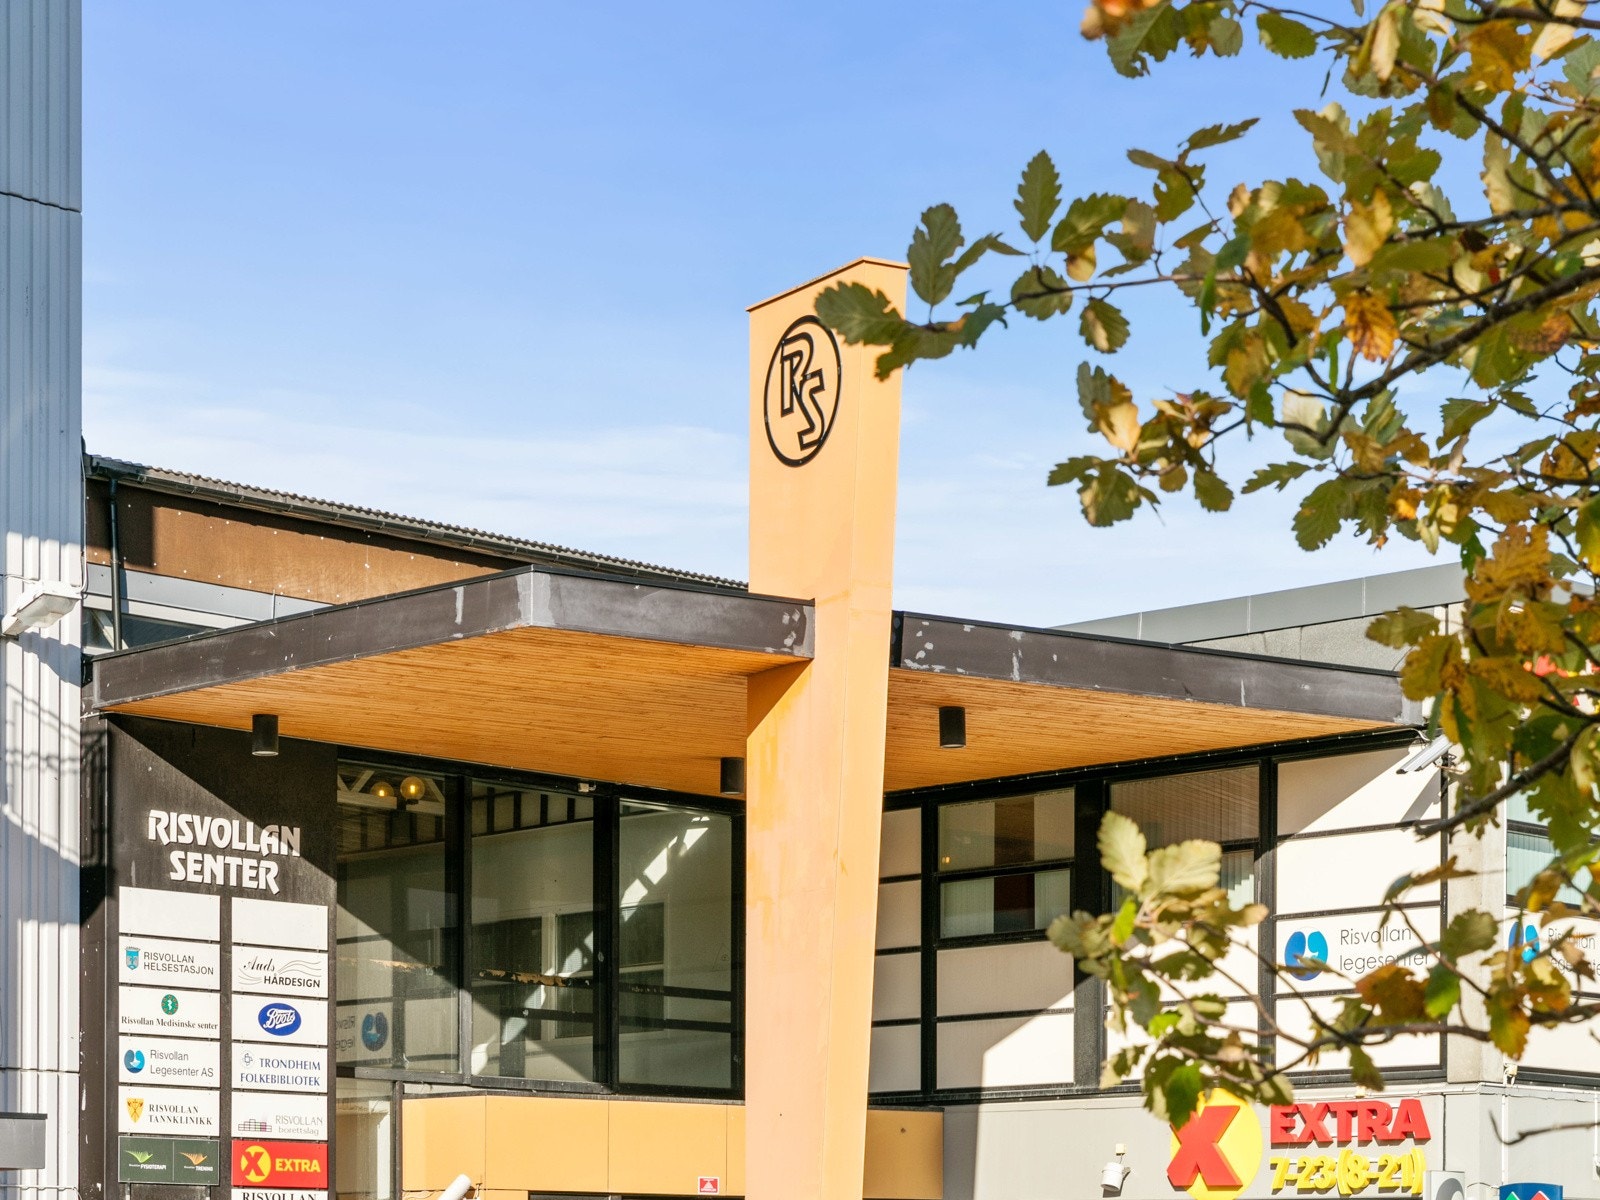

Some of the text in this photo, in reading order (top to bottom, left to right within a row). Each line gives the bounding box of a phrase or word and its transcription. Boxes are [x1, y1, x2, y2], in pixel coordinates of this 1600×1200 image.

[149, 810, 300, 857] RISVOLLAN
[169, 851, 280, 895] SENTER
[1340, 926, 1412, 946] Risvollan
[143, 952, 195, 963] RISVOLLAN
[243, 956, 275, 972] Auds
[143, 962, 214, 975] HELSESTASJON
[263, 973, 321, 988] HÅRDESIGN
[121, 1016, 218, 1030] Risvollan Medisinske senter
[263, 1008, 296, 1030] Boots
[150, 1049, 189, 1061] Risvollan
[150, 1065, 214, 1077] Legesenter AS
[259, 1058, 321, 1070] TRONDHEIM
[240, 1072, 320, 1086] FOLKEBIBLIOTEK
[149, 1104, 199, 1113] RISVOLLAN
[149, 1115, 212, 1125] TANNKLINIKK
[275, 1115, 323, 1126] RISVOLLAN
[1270, 1098, 1431, 1144] EXTRA
[278, 1126, 320, 1136] borettslag
[275, 1158, 321, 1172] EXTRA
